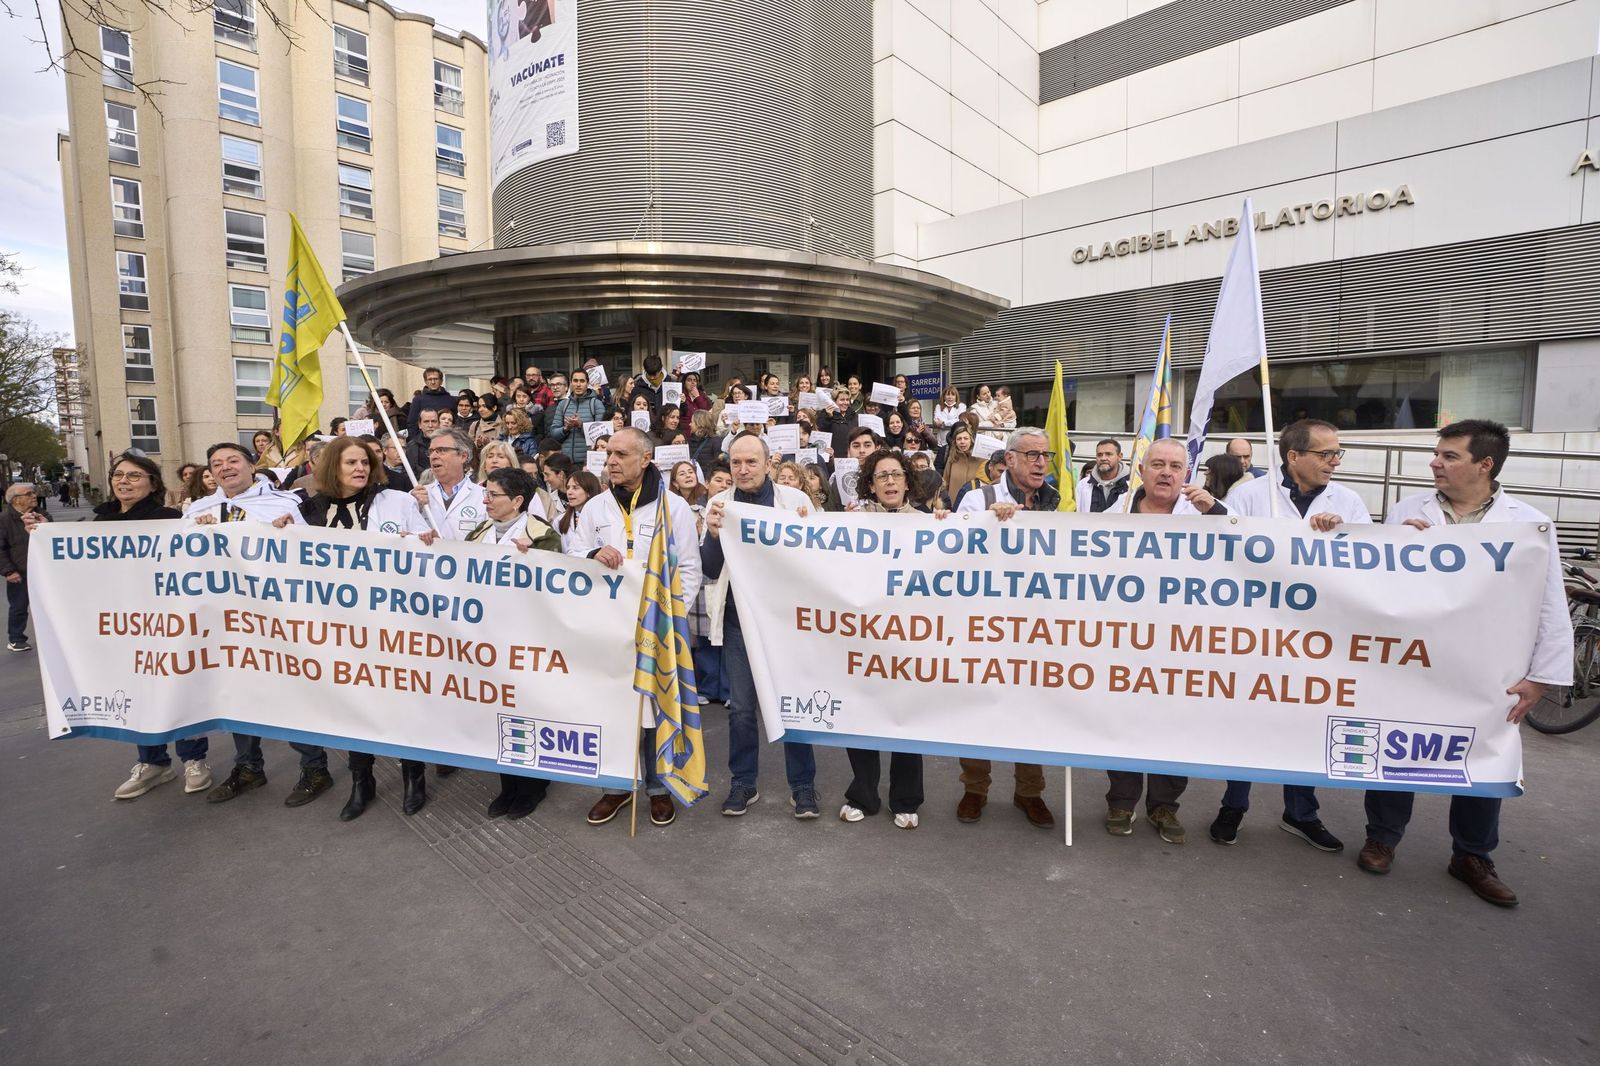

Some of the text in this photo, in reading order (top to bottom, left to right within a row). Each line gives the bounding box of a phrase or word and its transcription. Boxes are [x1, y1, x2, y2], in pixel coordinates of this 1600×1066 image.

[510, 53, 565, 87] VACÚNATE
[1072, 230, 1179, 264] OLAGIBEL
[911, 378, 941, 386] SARRERA
[52, 532, 625, 600] EUSKADI, POR UN ESTATUTO MÉDICO Y
[741, 519, 1513, 572] EUSKADI, POR UN ESTATUTO MÉDICO Y
[155, 571, 483, 623] FACULTATIVO PROPIO
[887, 571, 1317, 610] FACULTATIVO PROPIO
[98, 610, 570, 674] EUSKADI, ESTATUTU MEDIKO ETA
[797, 608, 1429, 667] EUSKADI, ESTATUTU MEDIKO ETA
[135, 645, 516, 708] FAKULTATIBO BATEN ALDE
[848, 652, 1354, 706] FAKULTATIBO BATEN ALDE
[539, 726, 598, 757] SME
[1384, 729, 1470, 762] SME
